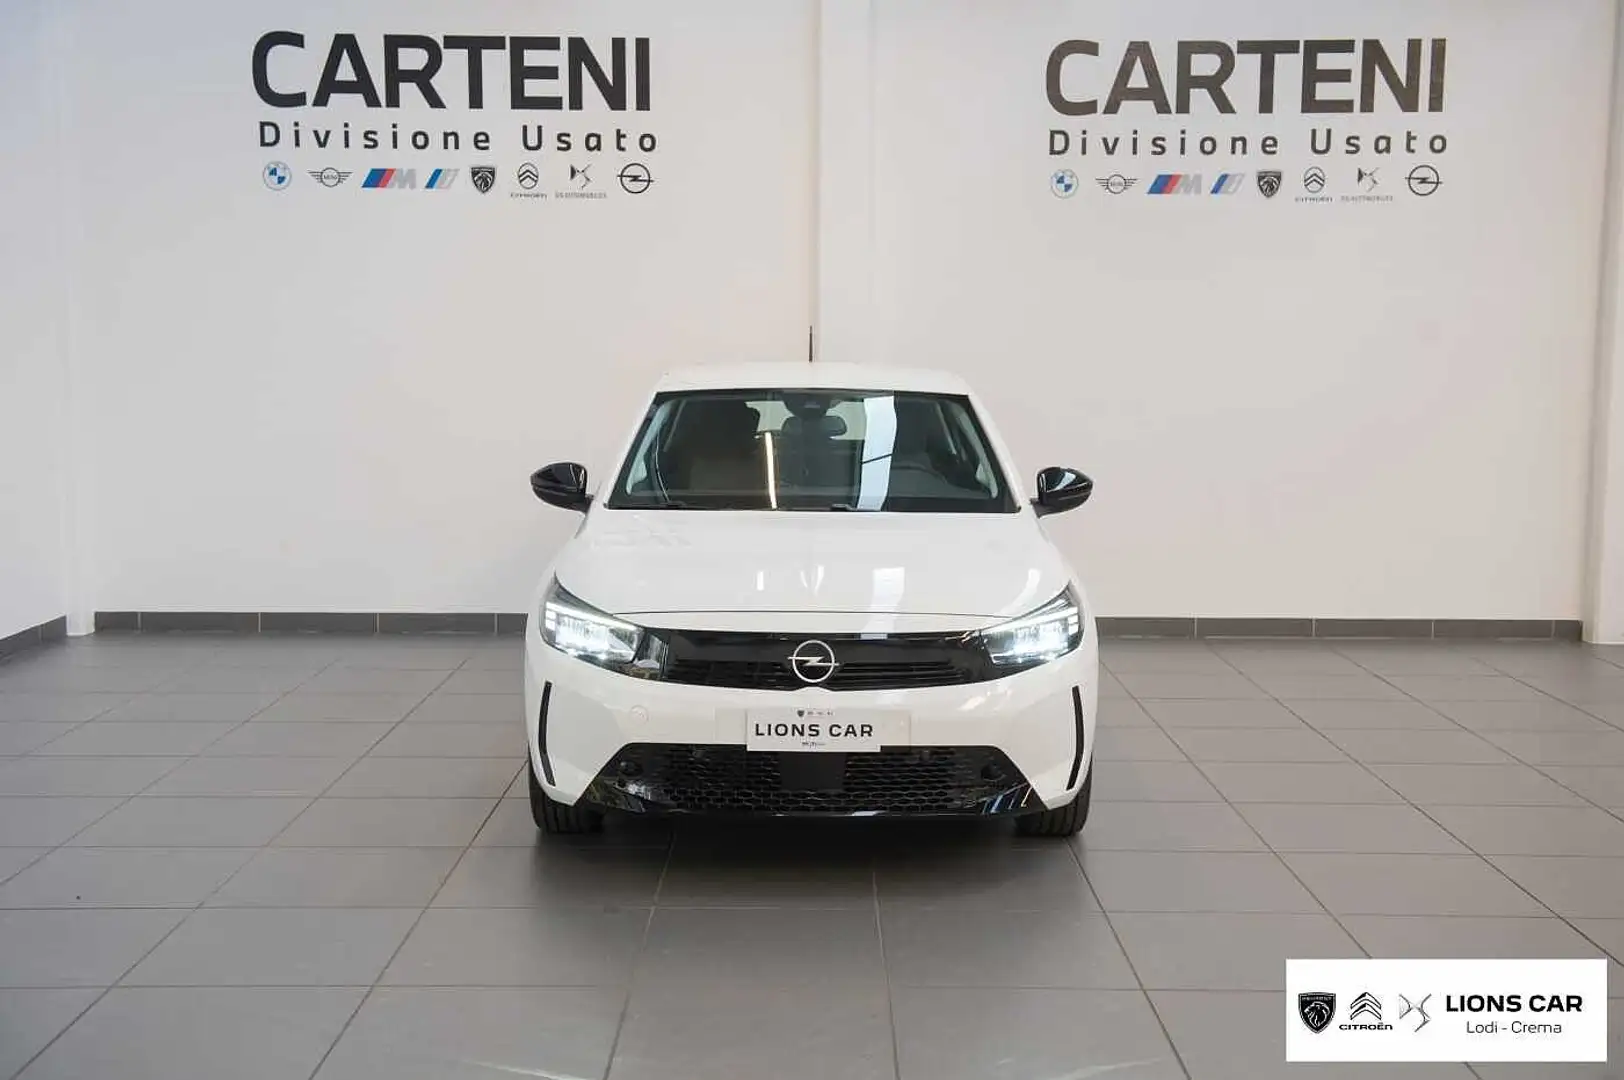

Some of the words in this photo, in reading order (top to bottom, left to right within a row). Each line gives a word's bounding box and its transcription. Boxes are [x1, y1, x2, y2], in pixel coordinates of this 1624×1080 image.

[252, 30, 651, 112] CARTENI
[1046, 38, 1447, 116] CARTENI
[259, 121, 491, 151] Divisione
[522, 124, 657, 153] Usato
[1049, 129, 1278, 156] Divisione
[1310, 128, 1447, 155] Usato
[755, 723, 820, 737] LIONS
[829, 723, 873, 738] CAR
